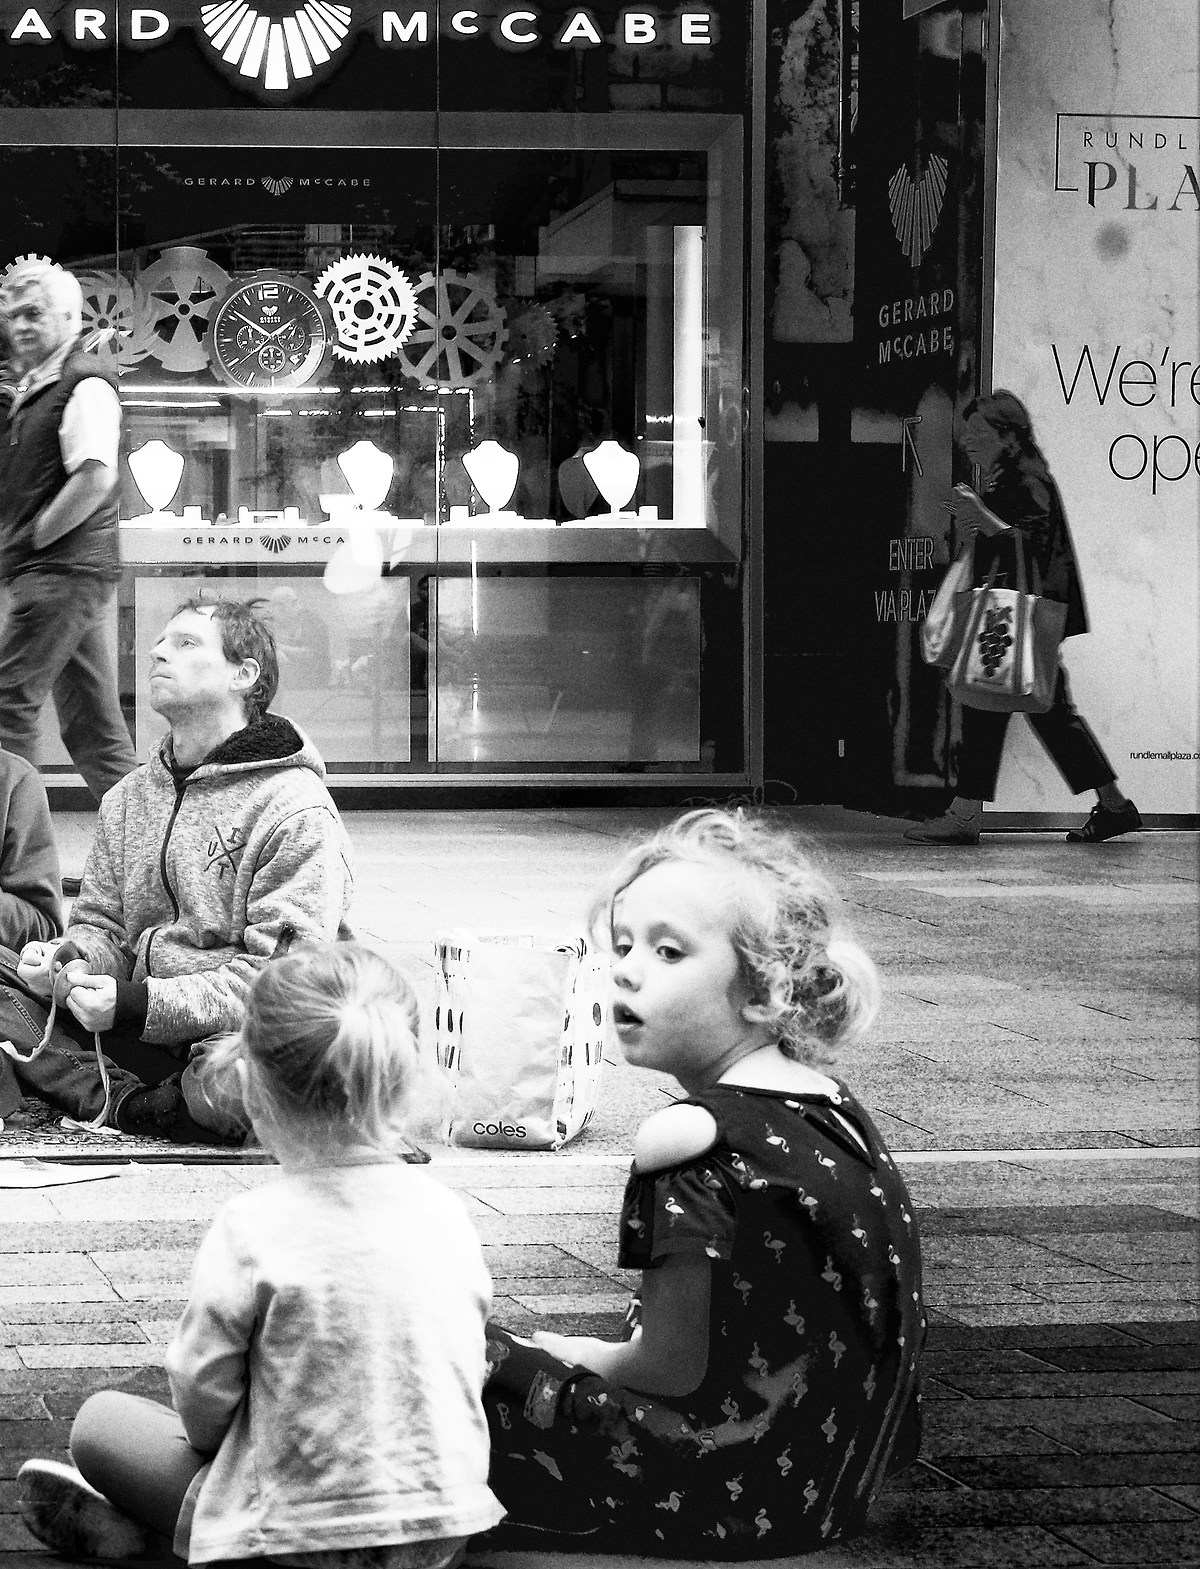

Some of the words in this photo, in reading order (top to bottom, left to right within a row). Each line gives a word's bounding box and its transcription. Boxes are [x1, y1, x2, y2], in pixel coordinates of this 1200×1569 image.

[1083, 131, 1200, 150] RUNDL
[184, 177, 256, 186] GERARD
[879, 288, 954, 328] GERARD
[1051, 344, 1200, 407] We'r
[1108, 434, 1200, 495] op
[182, 536, 254, 545] GERARD
[297, 536, 346, 544] McCA
[889, 537, 934, 571] ENTER
[874, 590, 897, 622] VIA
[473, 1120, 527, 1138] coles
